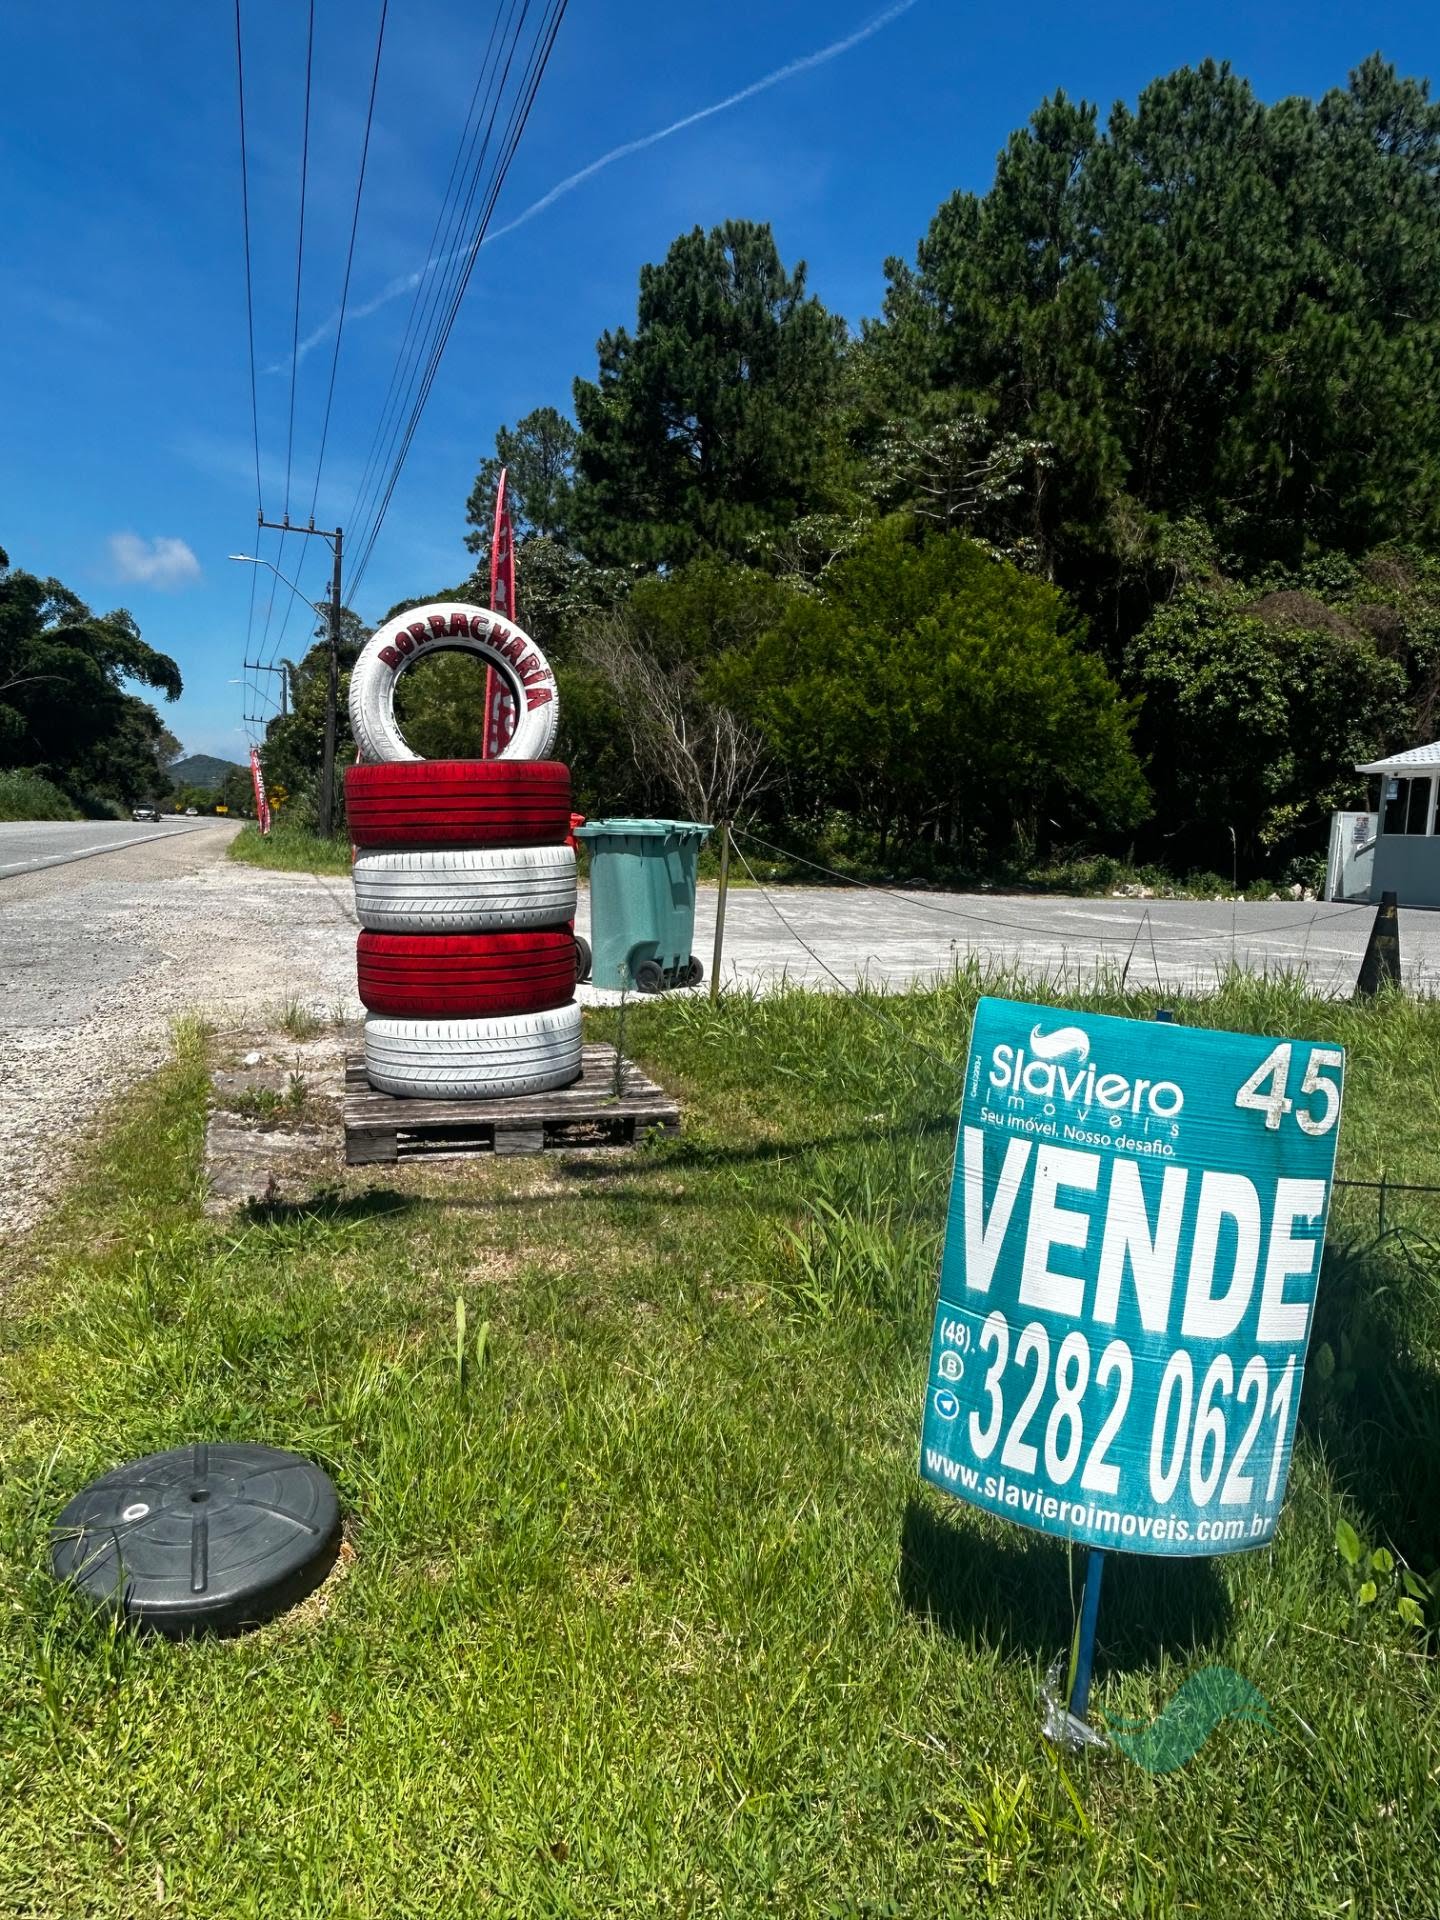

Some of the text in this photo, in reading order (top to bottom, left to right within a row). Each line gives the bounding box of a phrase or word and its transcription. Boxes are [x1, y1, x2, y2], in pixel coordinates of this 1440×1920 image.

[989, 1044, 1184, 1118] Slaviero
[1235, 1043, 1342, 1136] 45
[980, 1107, 1004, 1125] Seu
[1064, 1124, 1111, 1146] Nosso
[1115, 1134, 1176, 1156] desafio.
[963, 1125, 1327, 1341] VENDE
[969, 1310, 1133, 1495] 3282
[1150, 1349, 1296, 1507] 0621
[926, 1448, 1272, 1541] www.slavieroimoveis.com.br
